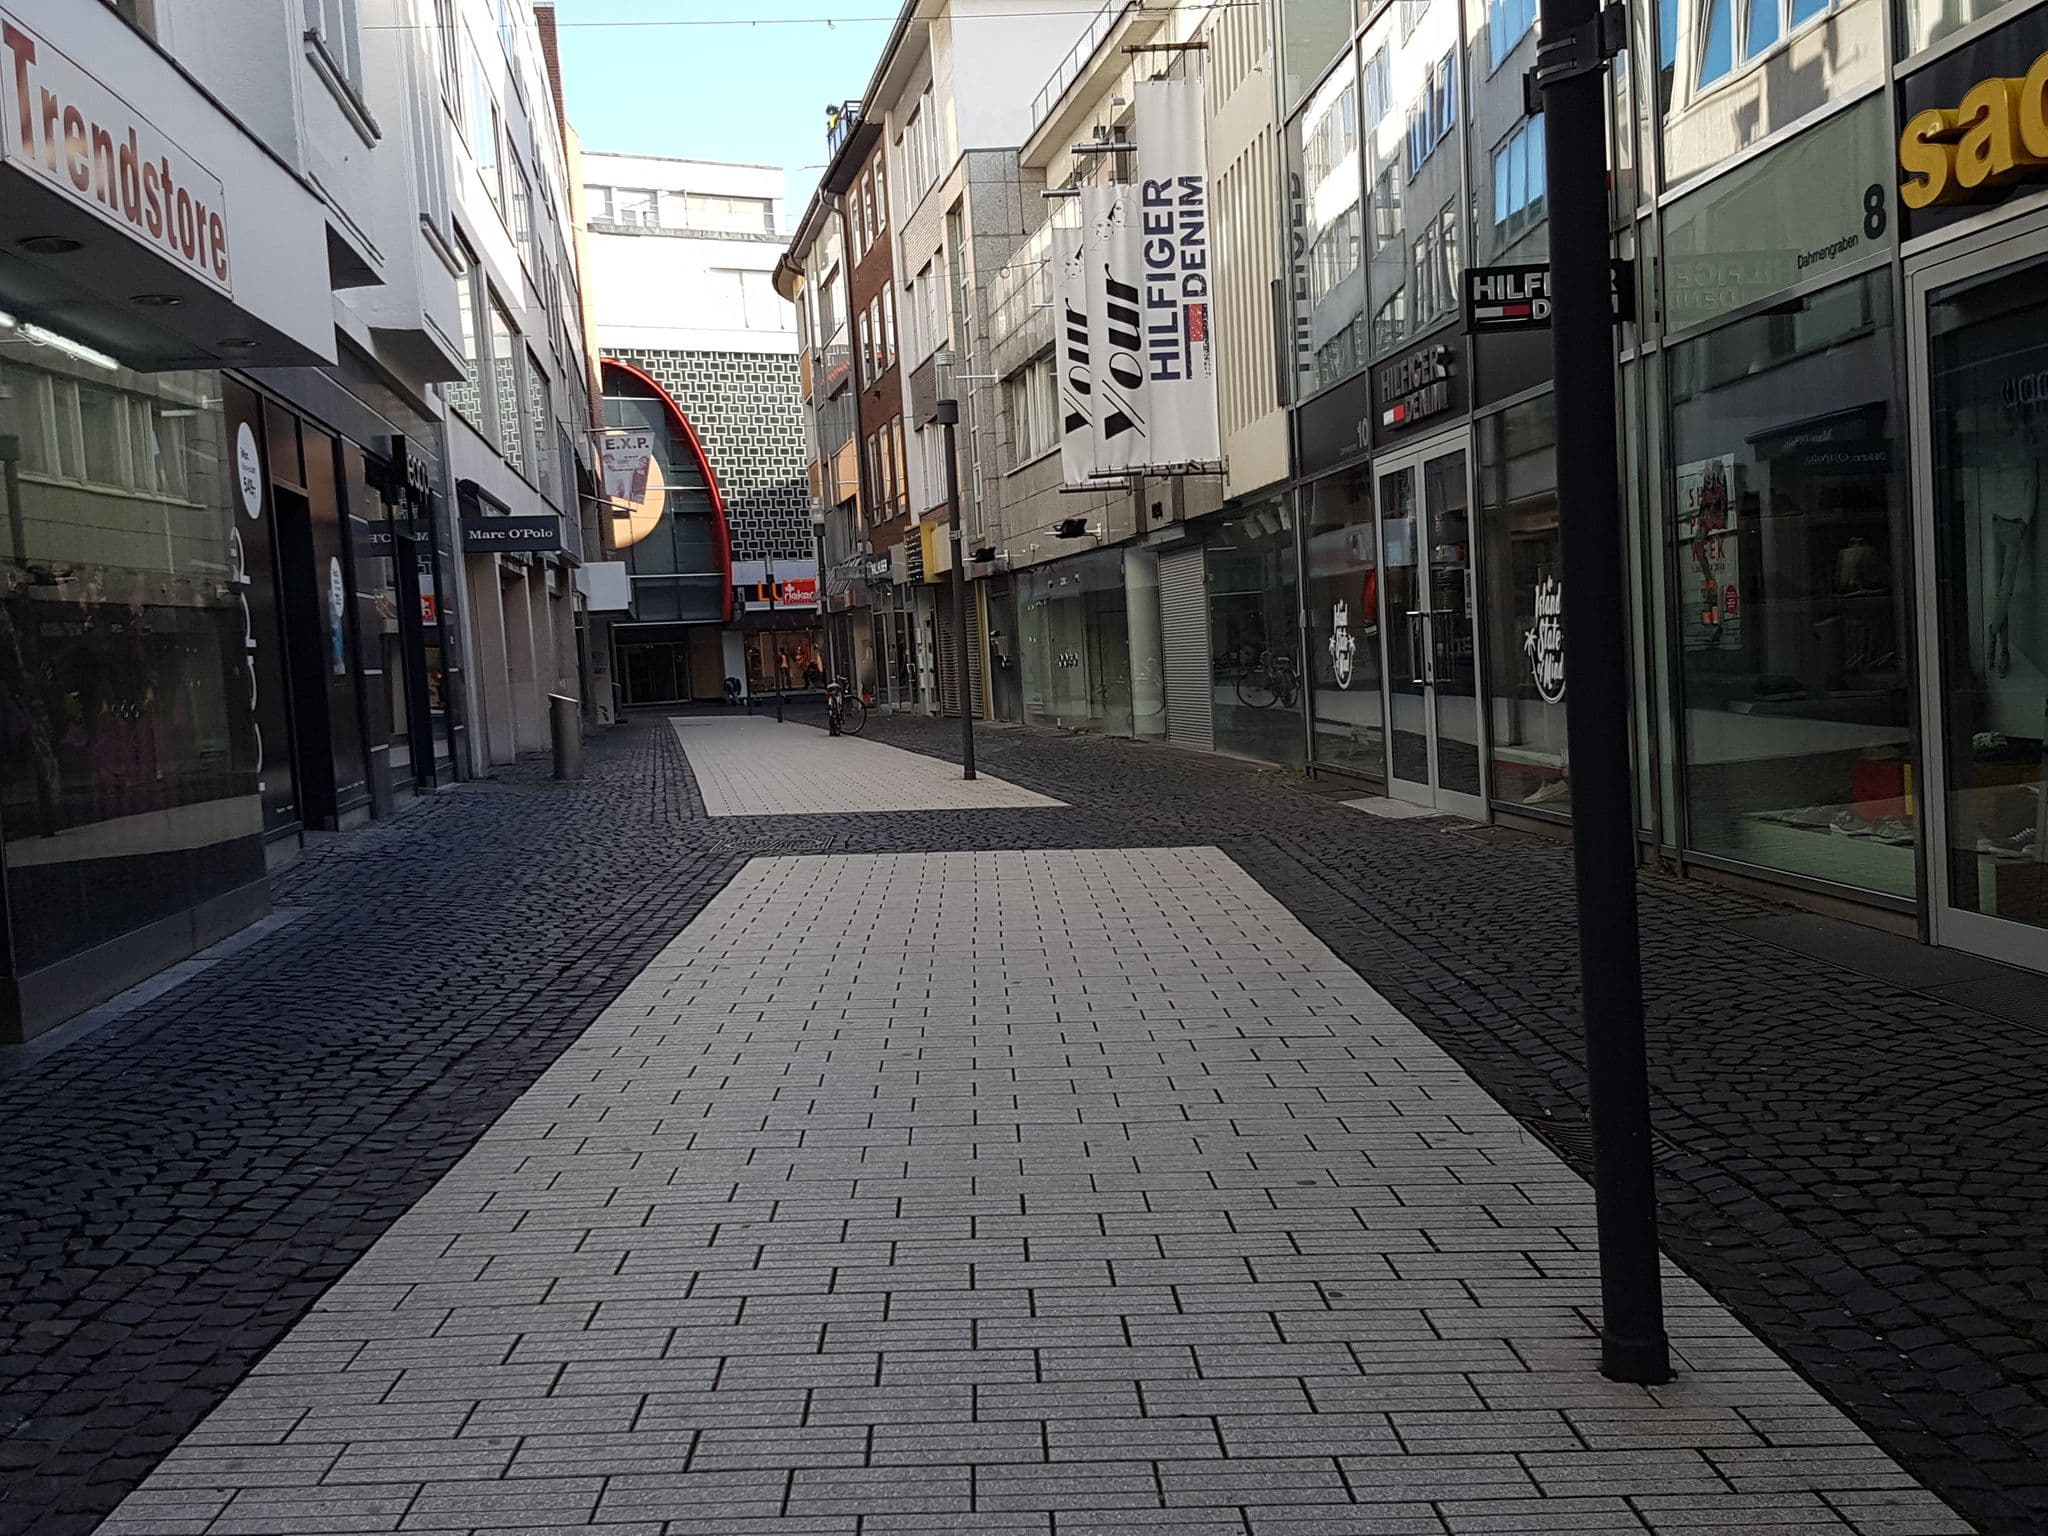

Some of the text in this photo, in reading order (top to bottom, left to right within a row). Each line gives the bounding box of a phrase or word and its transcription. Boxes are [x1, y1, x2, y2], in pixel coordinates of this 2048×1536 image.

[2, 18, 228, 282] Trendstore
[1178, 175, 1208, 298] DENIM
[1863, 184, 1887, 240] 8
[1797, 233, 1860, 270] Dahmengraben
[1142, 177, 1181, 381] HILFIGER
[1381, 344, 1445, 403] HILFIGER
[1404, 381, 1448, 423] DENIM
[605, 437, 650, 450] E.X.P.
[1356, 417, 1369, 448] 10
[468, 527, 553, 540] Marc O'Polo
